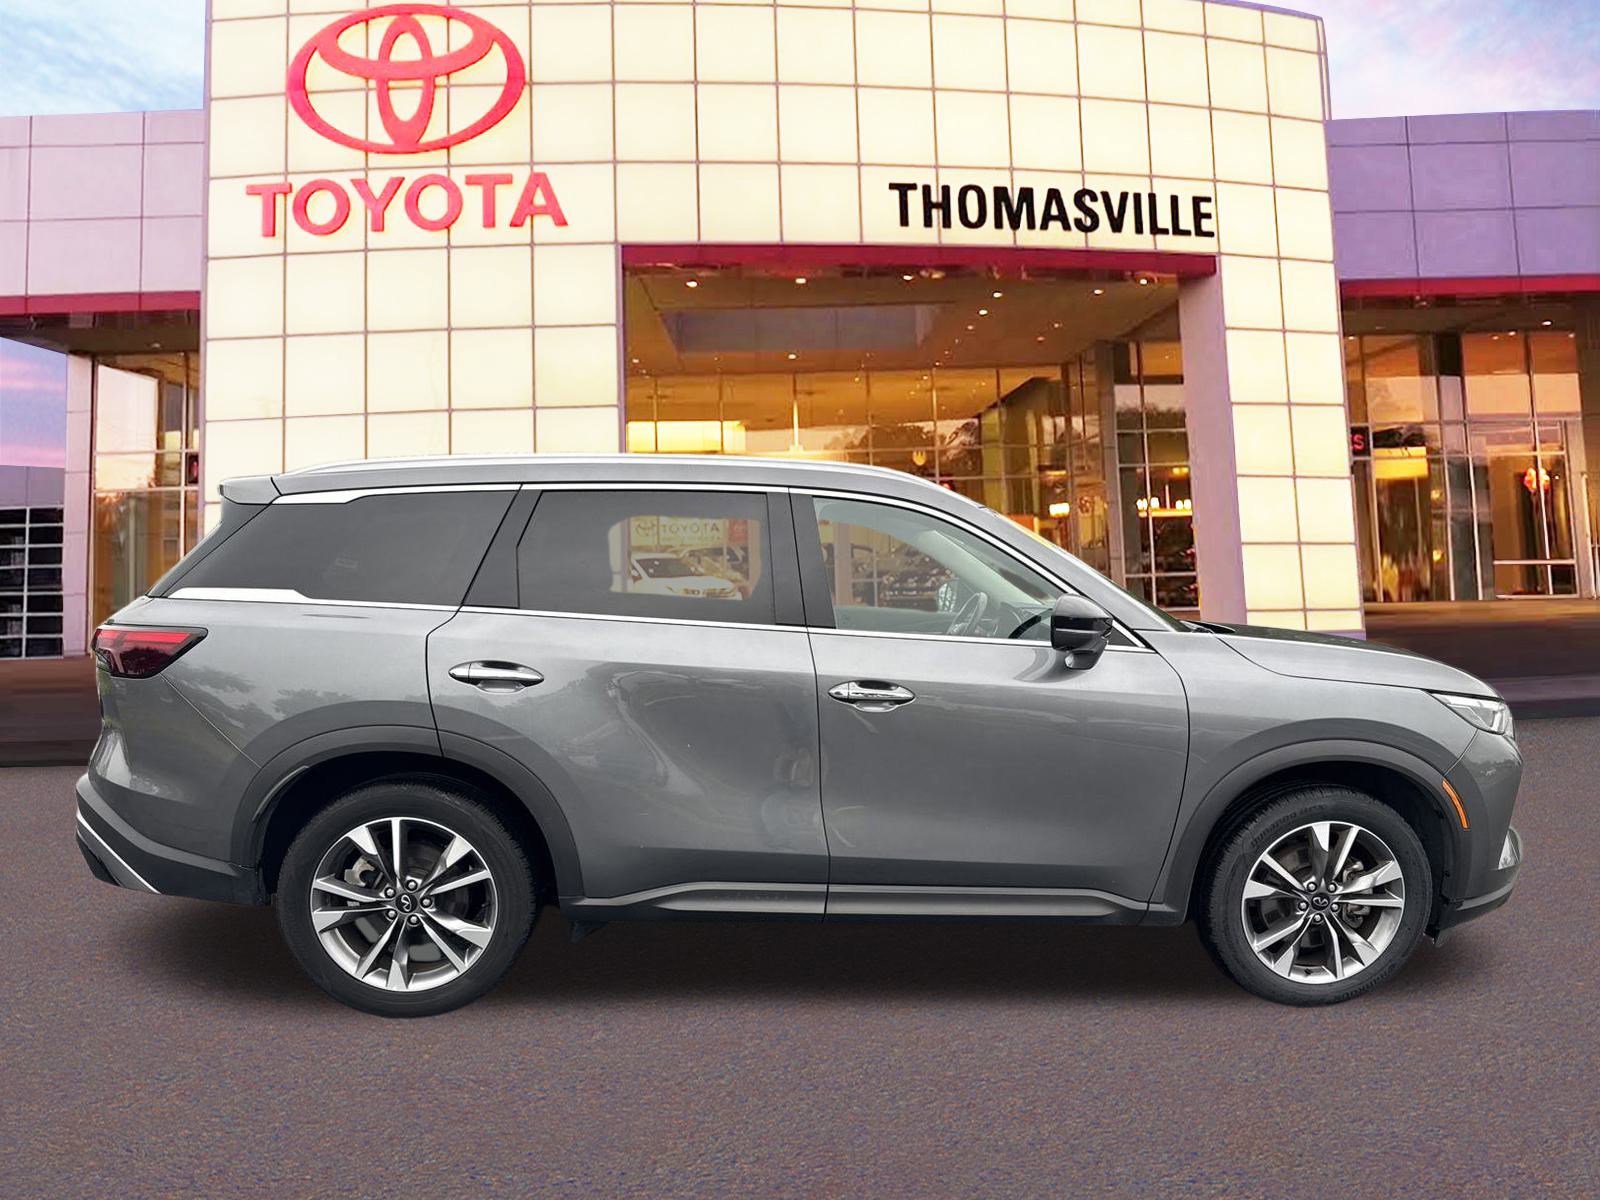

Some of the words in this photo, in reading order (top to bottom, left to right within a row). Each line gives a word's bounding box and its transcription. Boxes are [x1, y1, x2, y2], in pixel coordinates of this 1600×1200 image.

[246, 172, 568, 237] TOYOTA
[889, 182, 1216, 238] THOMASVILLE
[662, 523, 720, 534] TOYOTA
